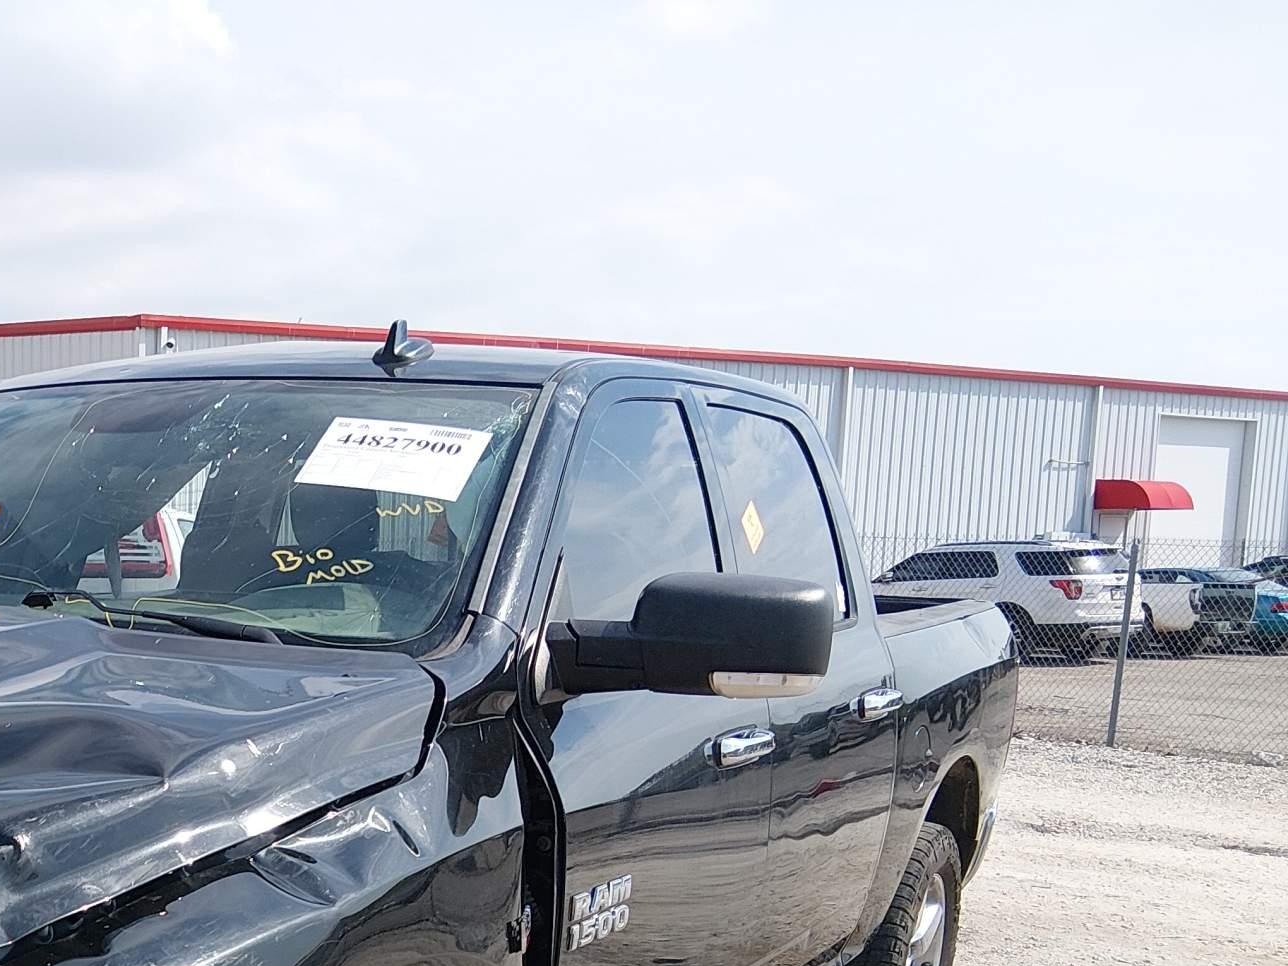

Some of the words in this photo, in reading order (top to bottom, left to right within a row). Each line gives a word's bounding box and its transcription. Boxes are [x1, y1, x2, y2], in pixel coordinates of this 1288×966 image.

[337, 432, 462, 456] 44827900
[569, 873, 632, 921] RAM
[567, 904, 630, 952] 1500
